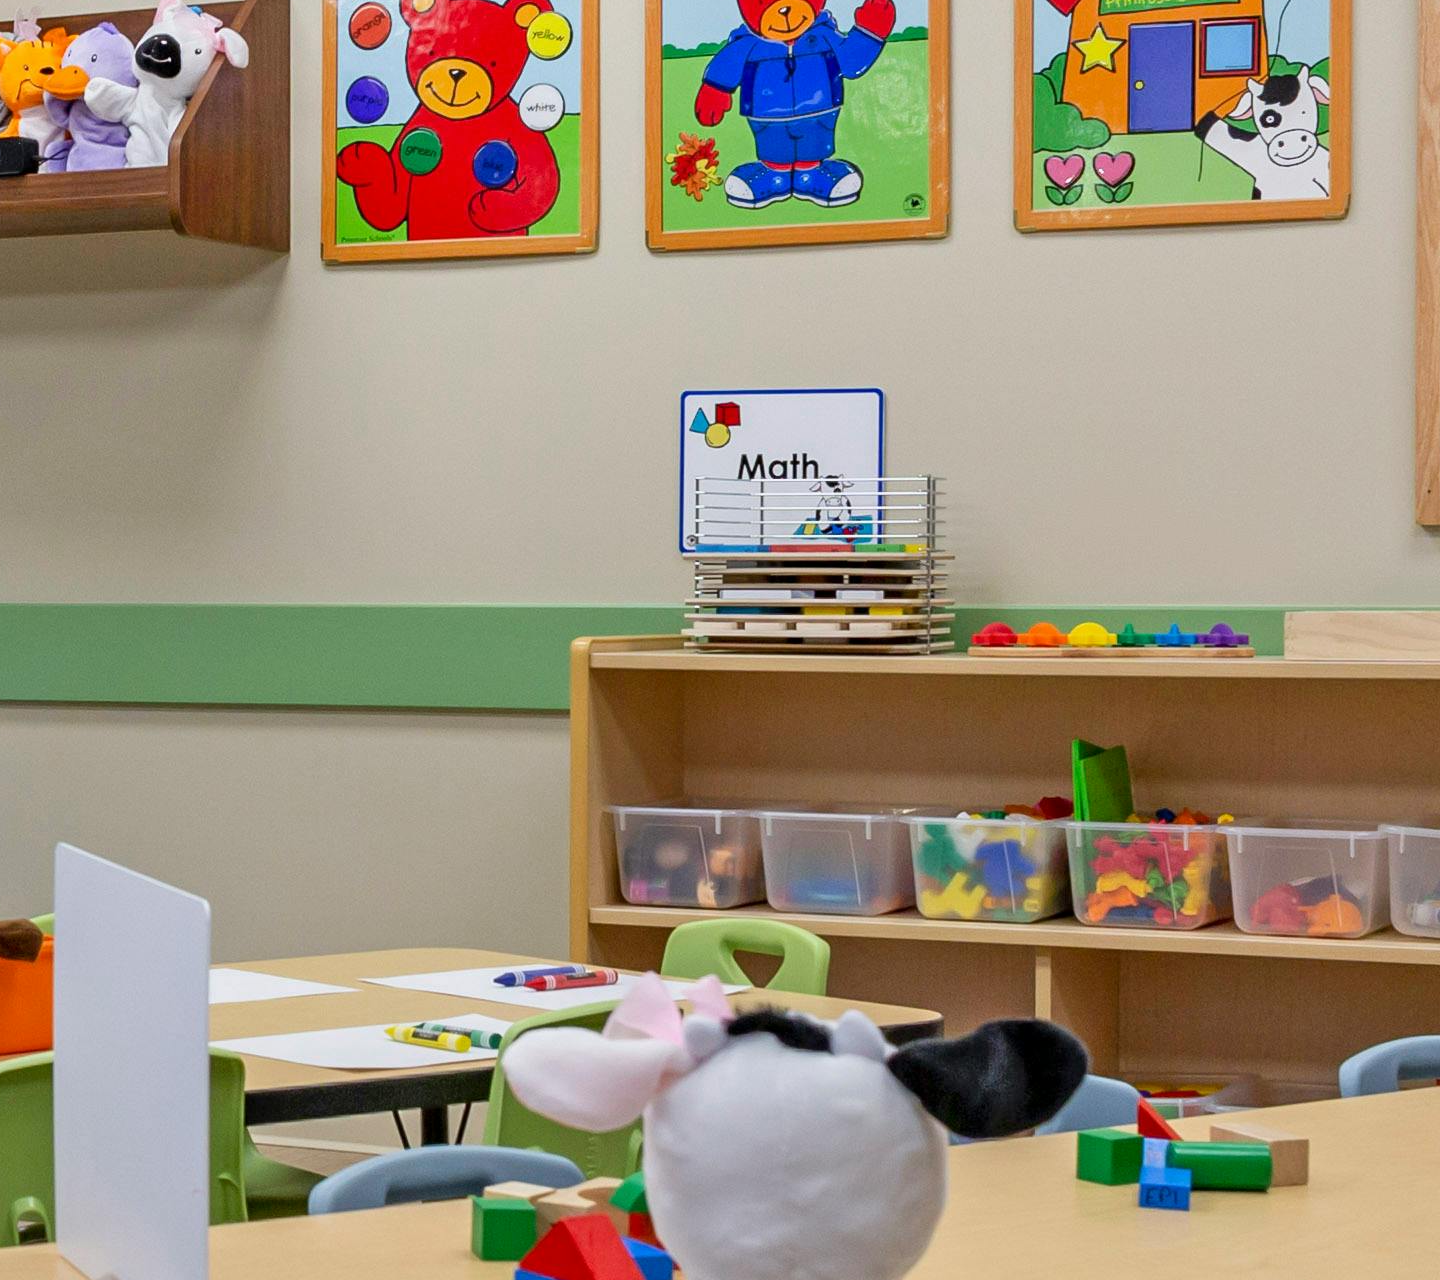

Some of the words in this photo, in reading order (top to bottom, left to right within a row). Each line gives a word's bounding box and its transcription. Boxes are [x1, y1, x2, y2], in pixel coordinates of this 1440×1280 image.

[353, 13, 387, 38] orange
[532, 30, 564, 42] yellow
[351, 94, 383, 106] purple
[527, 103, 556, 112] white
[404, 144, 436, 157] green
[738, 452, 820, 480] Math
